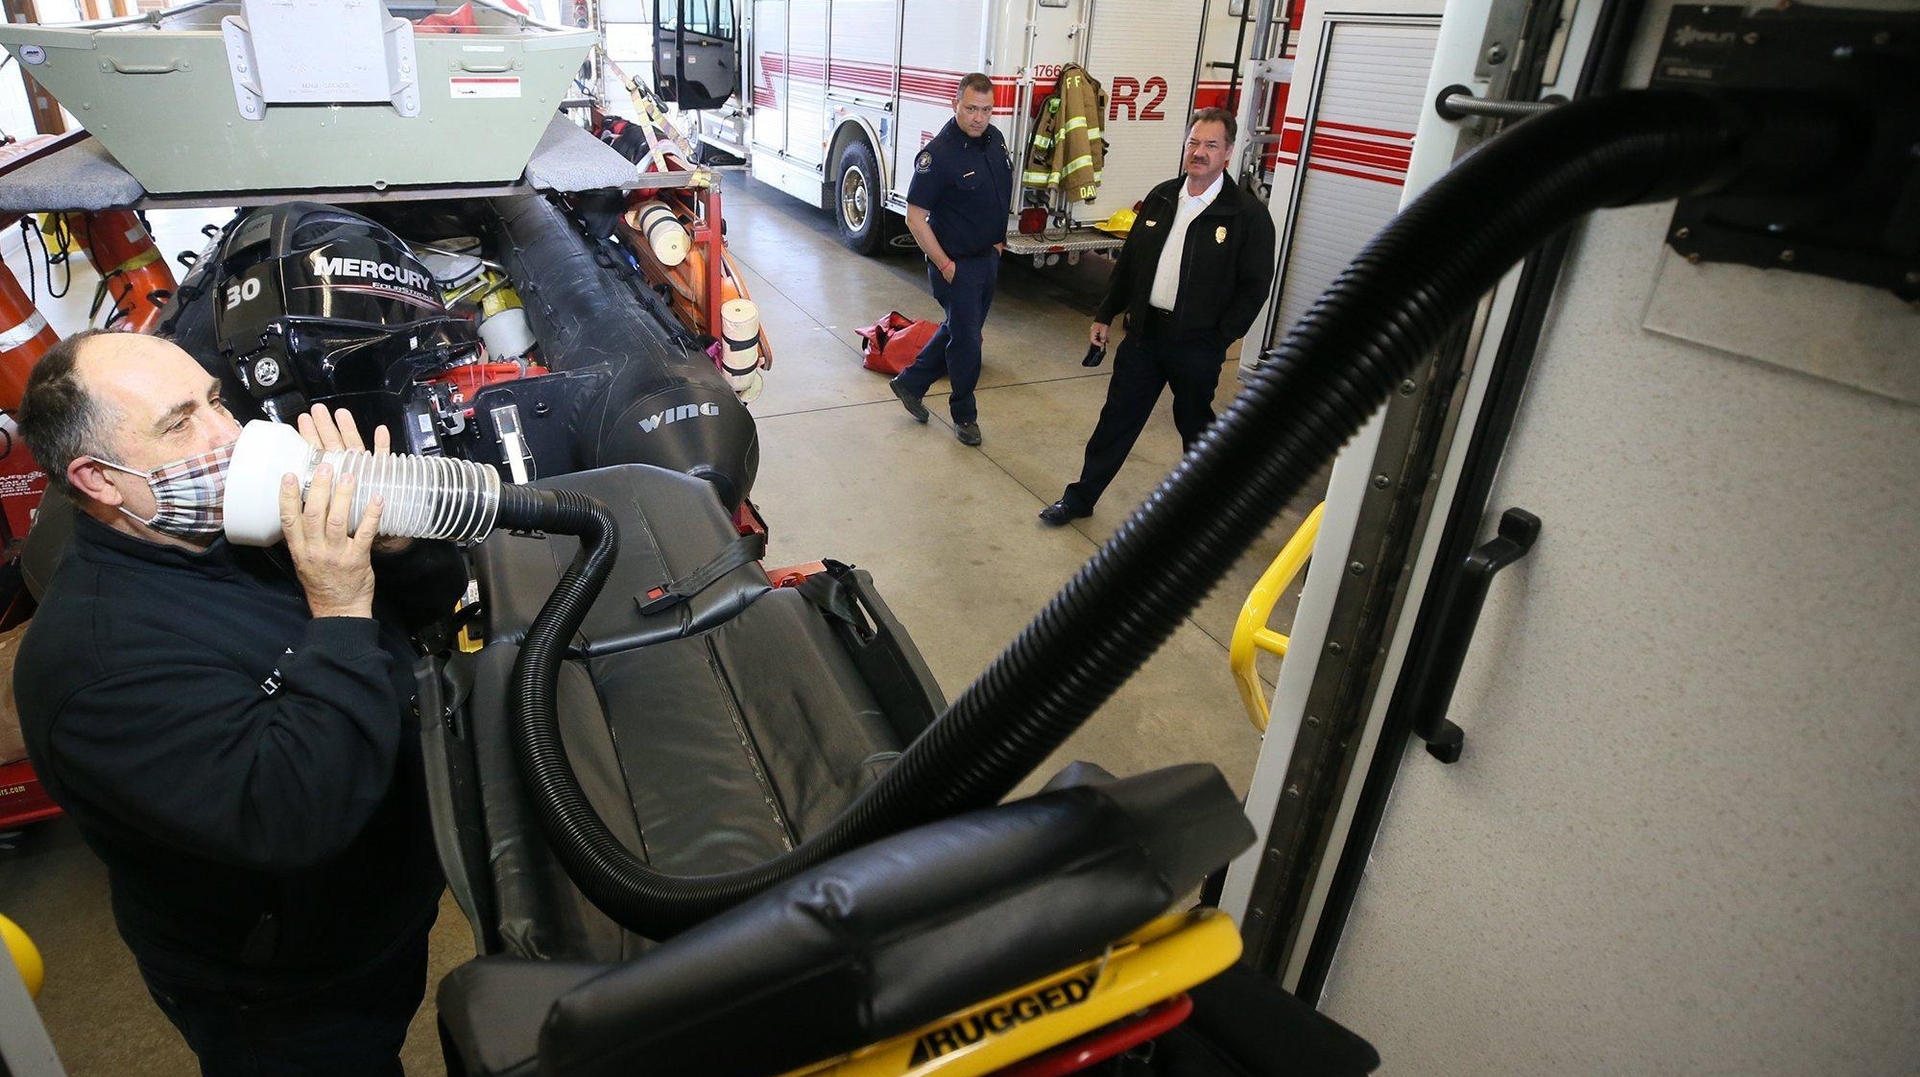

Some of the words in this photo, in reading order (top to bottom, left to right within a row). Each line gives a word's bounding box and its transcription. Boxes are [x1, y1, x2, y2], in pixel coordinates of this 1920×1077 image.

[1108, 76, 1168, 121] R2
[313, 256, 430, 291] MERCURY
[372, 282, 435, 300] FOURSTROKE
[226, 278, 261, 311] 30
[925, 979, 1090, 1058] RUGGED
